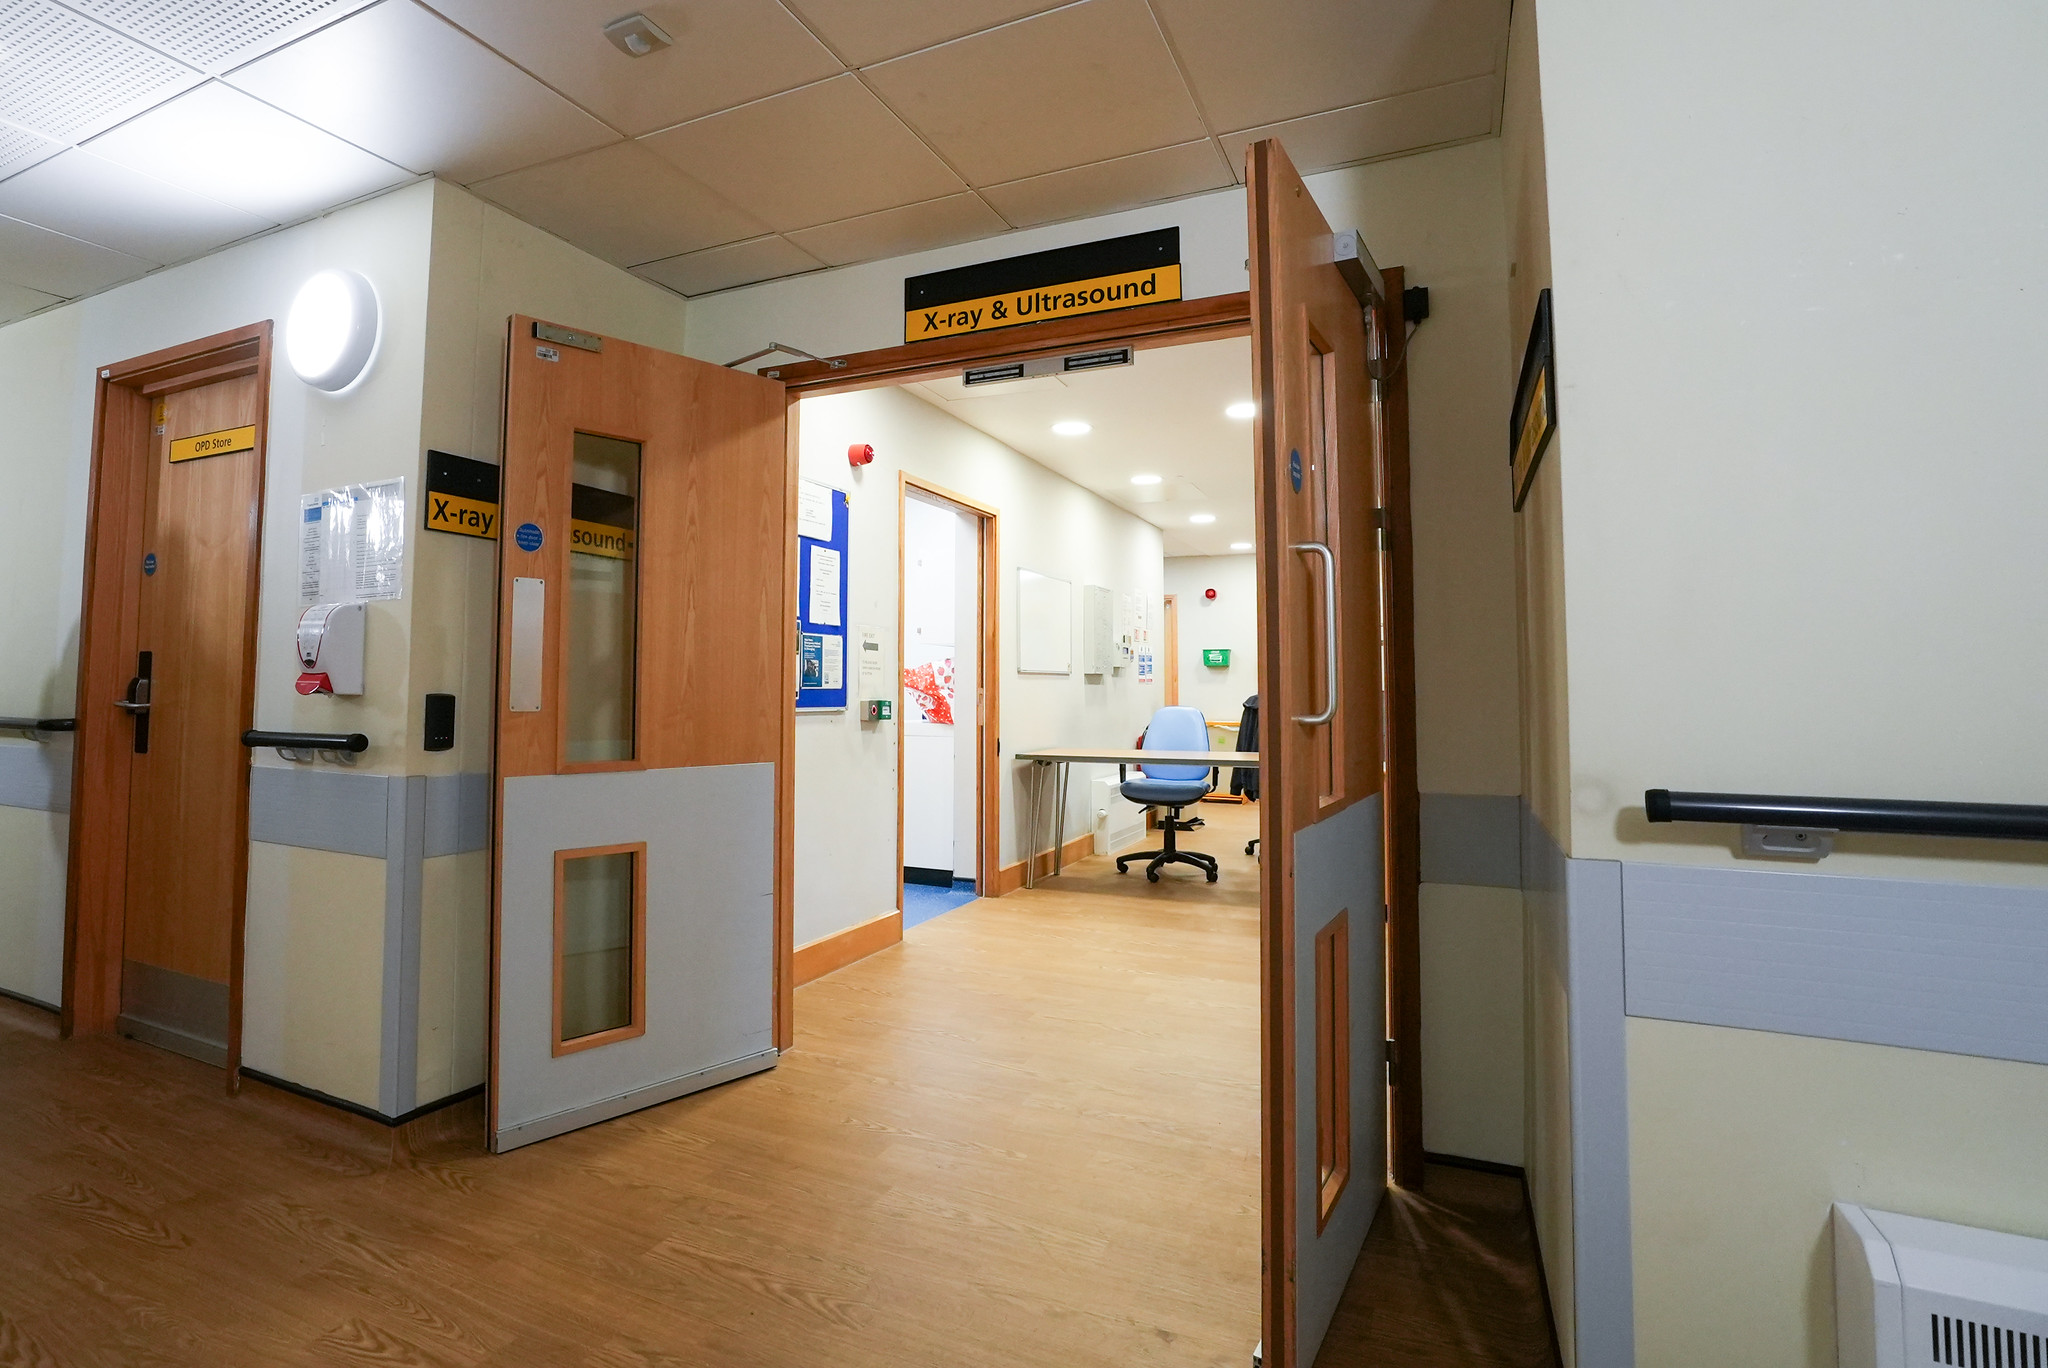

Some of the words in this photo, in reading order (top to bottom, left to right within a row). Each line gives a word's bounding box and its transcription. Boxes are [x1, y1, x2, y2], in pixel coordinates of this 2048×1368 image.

[923, 308, 983, 332] X-ray
[991, 300, 1008, 320] &
[1016, 273, 1157, 316] Ultrasound
[195, 439, 211, 453] OPD
[212, 437, 232, 449] Store
[432, 498, 494, 534] X-ray
[571, 529, 626, 552] sound
